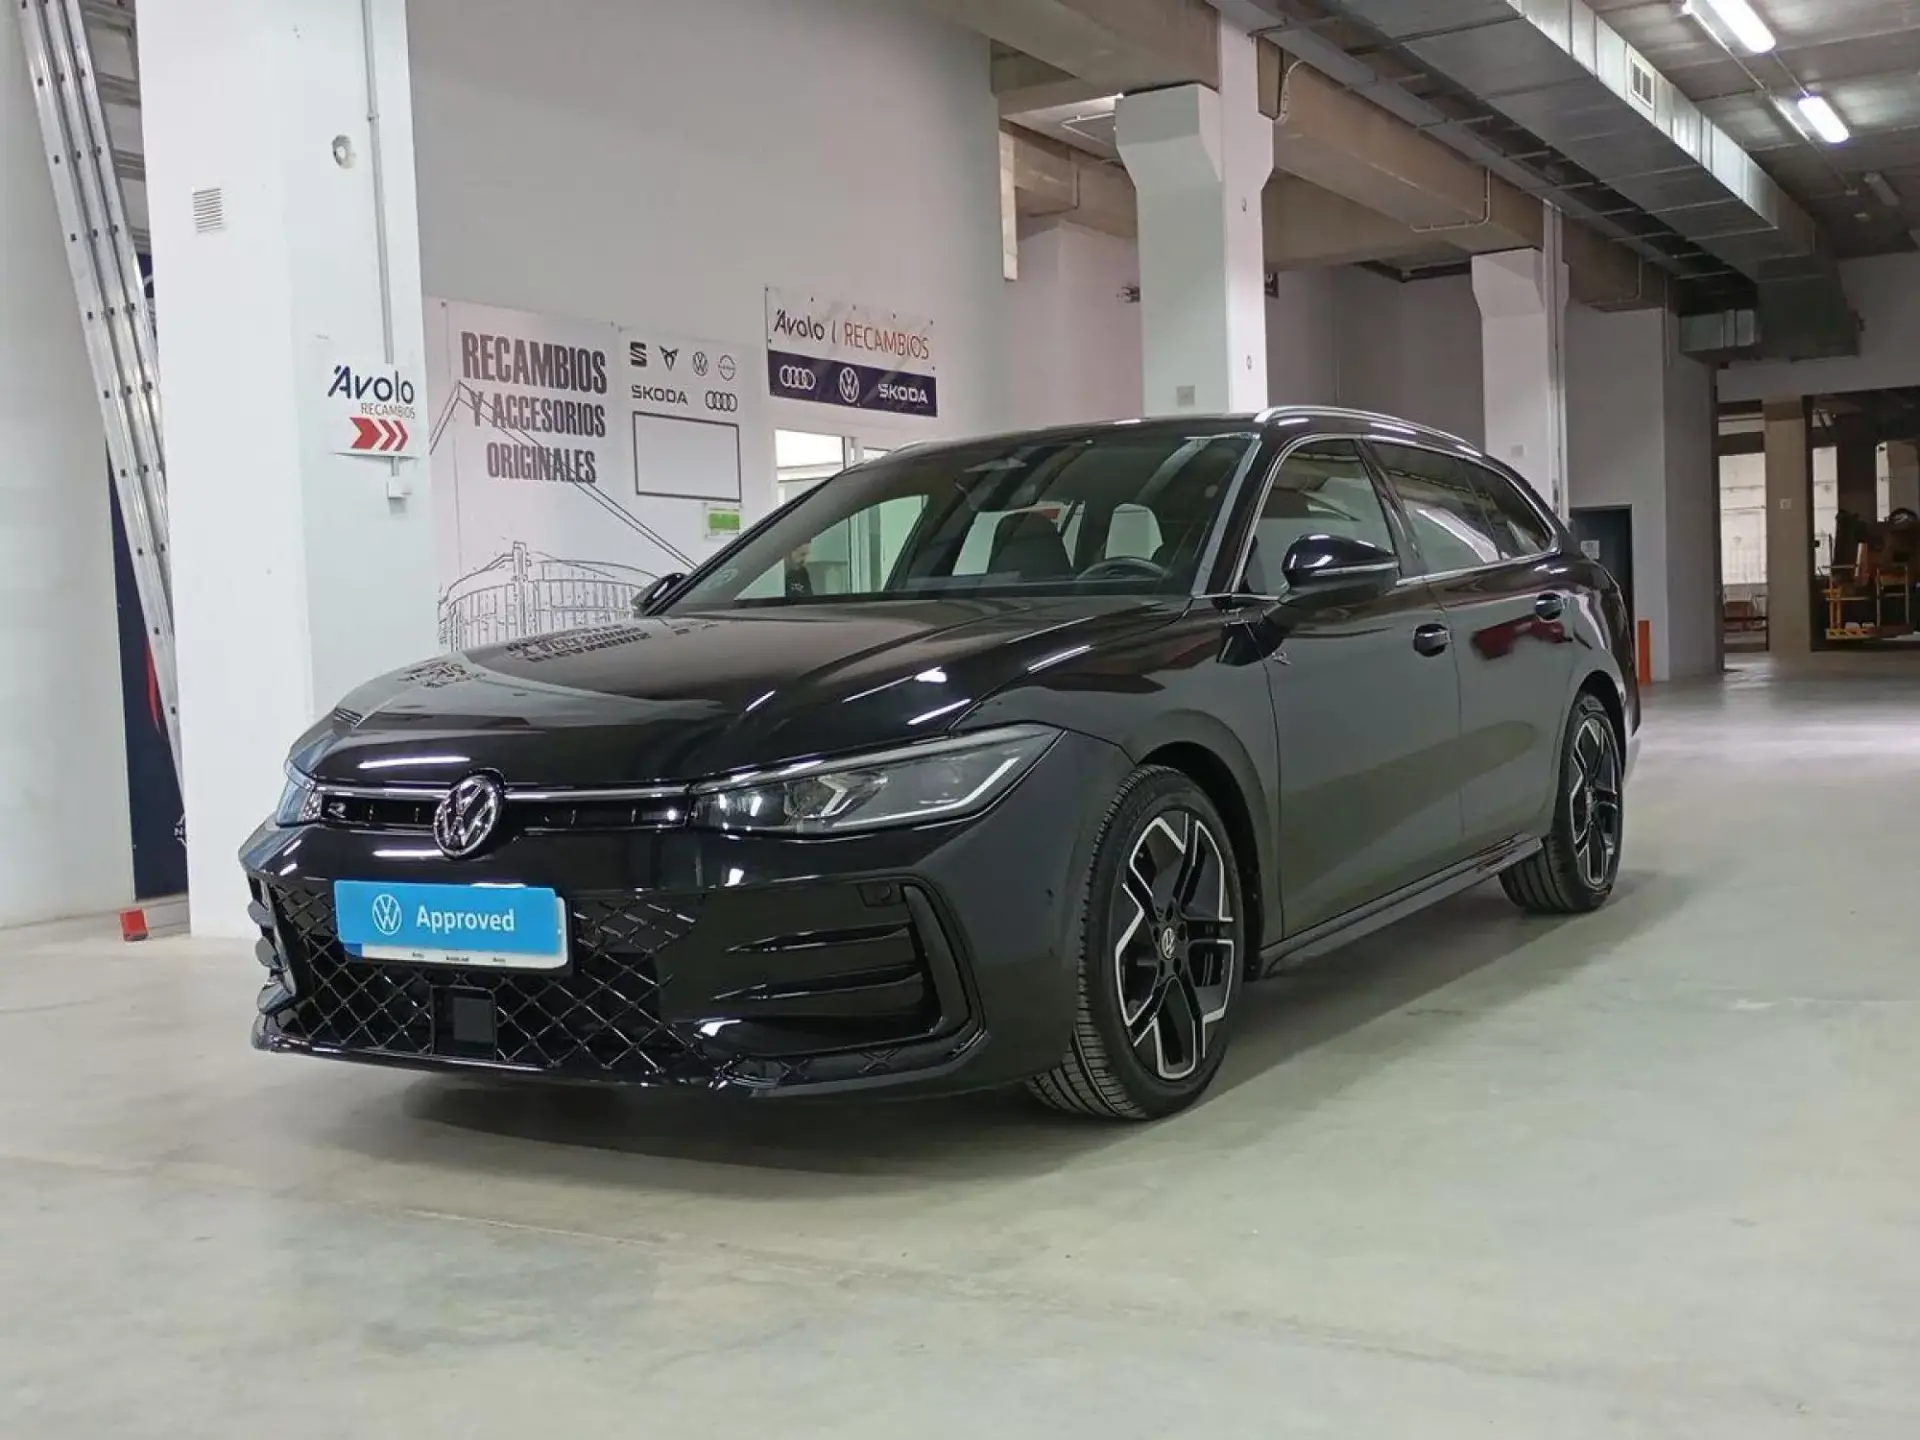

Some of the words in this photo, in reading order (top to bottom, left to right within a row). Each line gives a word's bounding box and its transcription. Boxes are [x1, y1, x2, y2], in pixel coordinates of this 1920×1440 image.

[844, 322, 929, 360] RECAMBIOS
[461, 331, 607, 394] RECAMBIOS
[470, 390, 484, 427] Y
[492, 393, 606, 438] ACCESORIOS
[486, 442, 596, 483] ORIGINALES
[416, 905, 515, 934] Approved
